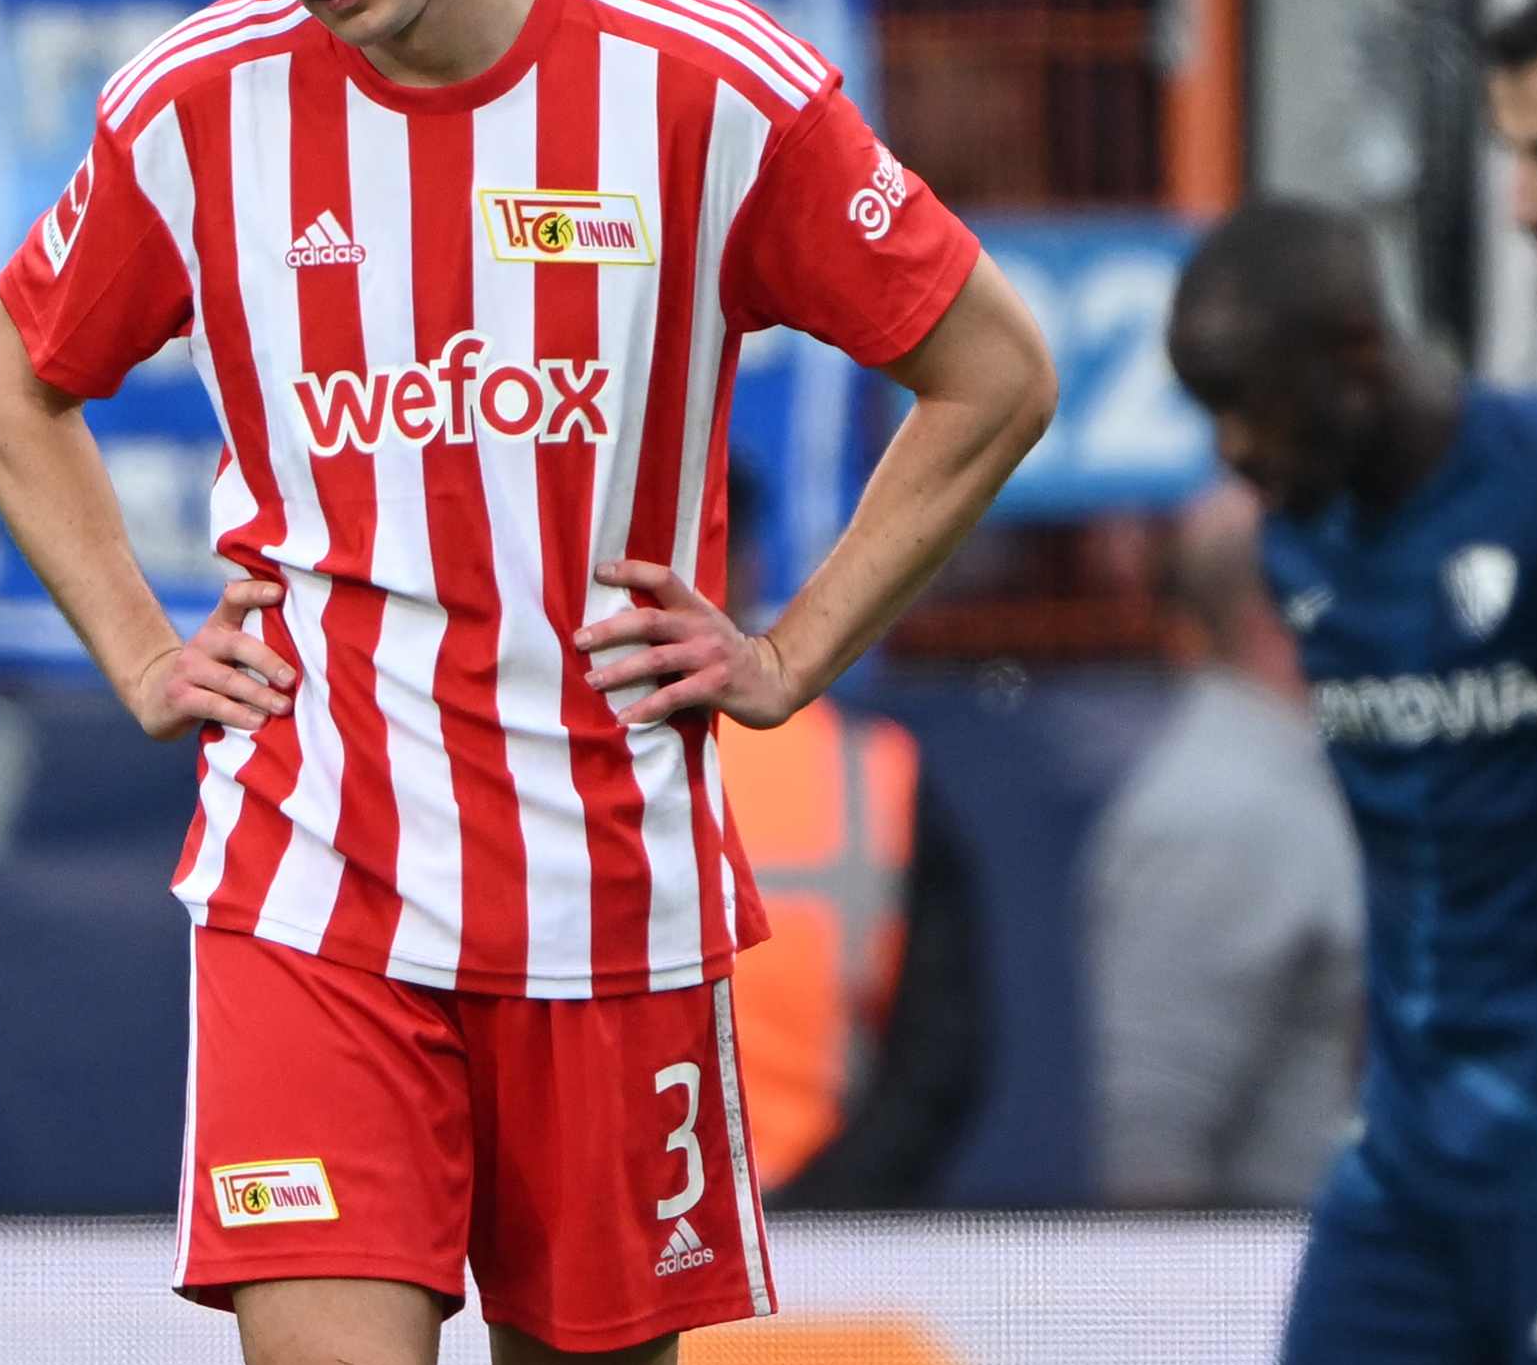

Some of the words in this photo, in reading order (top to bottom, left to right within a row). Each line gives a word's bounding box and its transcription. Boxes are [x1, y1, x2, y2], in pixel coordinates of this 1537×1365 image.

[575, 219, 636, 250] UNION
[285, 242, 366, 268] adidas
[289, 334, 614, 453] wefox
[654, 1061, 705, 1220] 3
[270, 1184, 322, 1208] UNION
[654, 1246, 715, 1278] adidas
